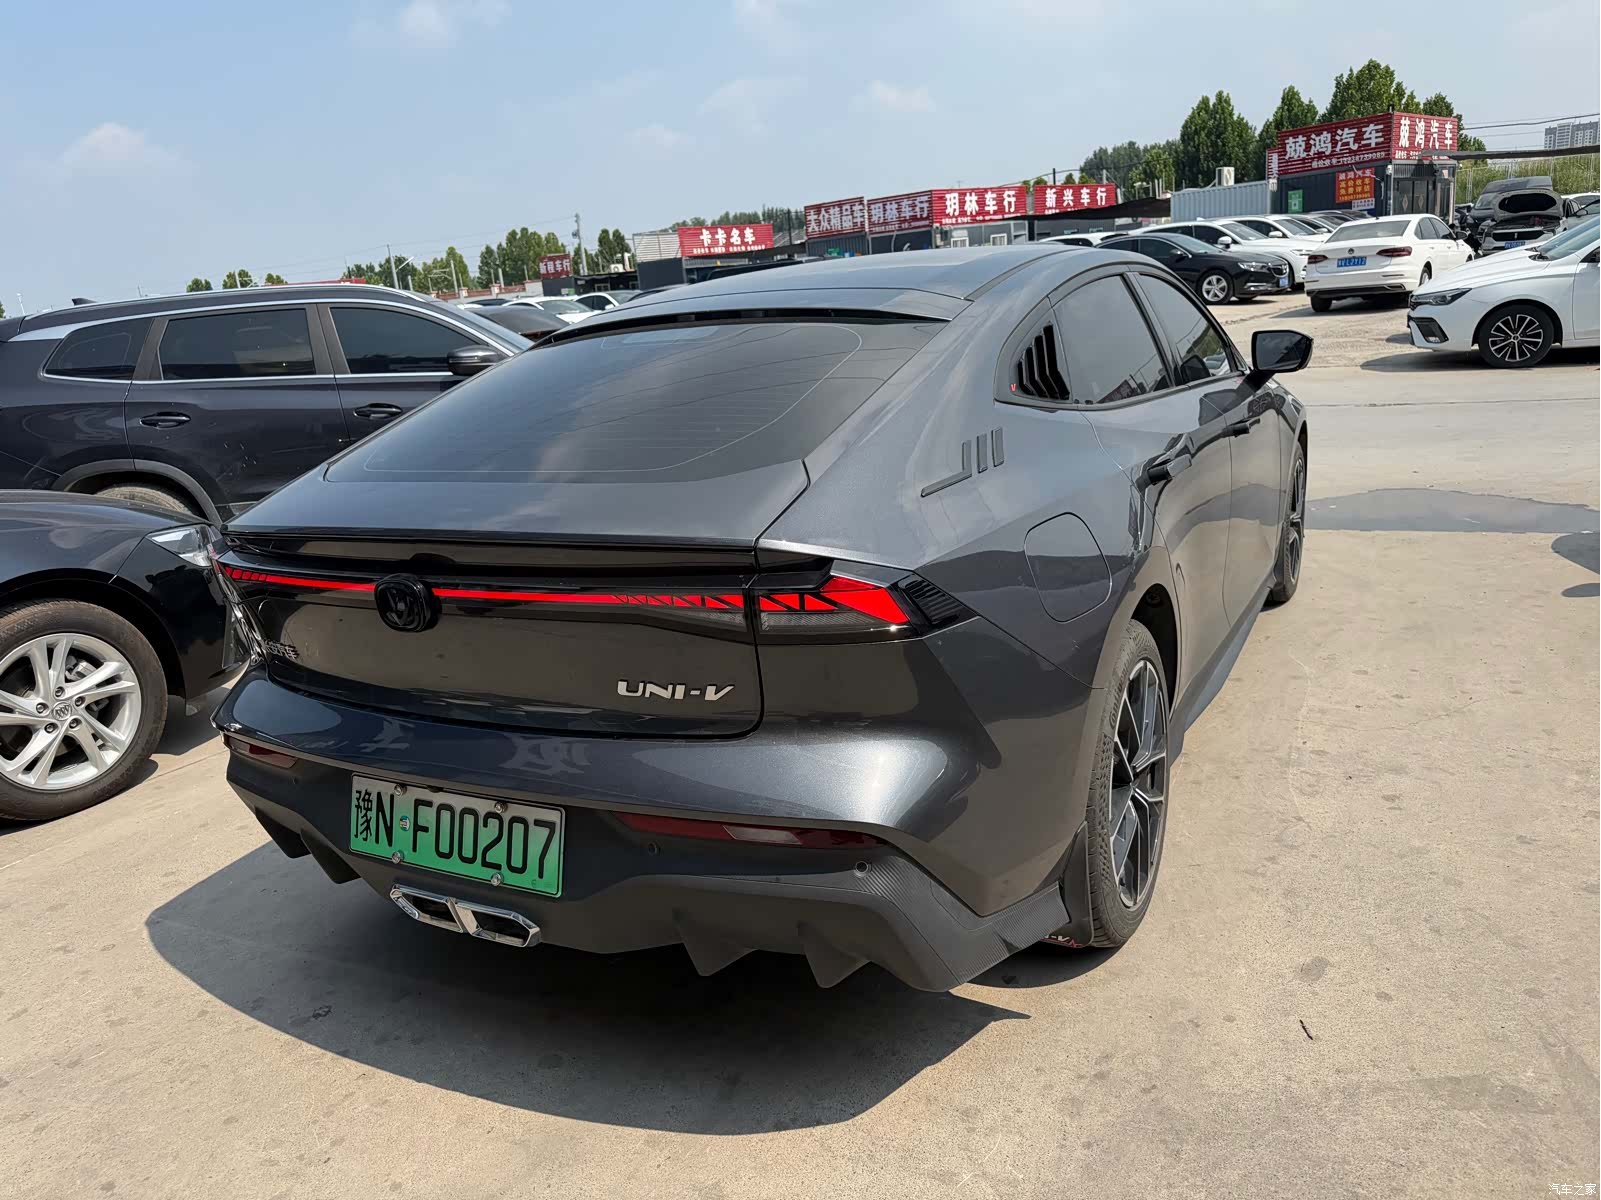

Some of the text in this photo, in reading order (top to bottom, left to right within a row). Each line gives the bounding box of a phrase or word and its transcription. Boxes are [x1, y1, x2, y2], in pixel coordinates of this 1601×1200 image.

[945, 191, 1017, 216] 玥林车行
[1045, 187, 1107, 208] 新兴车行
[700, 227, 756, 247] 卡卡名车
[617, 680, 735, 701] UNI-V
